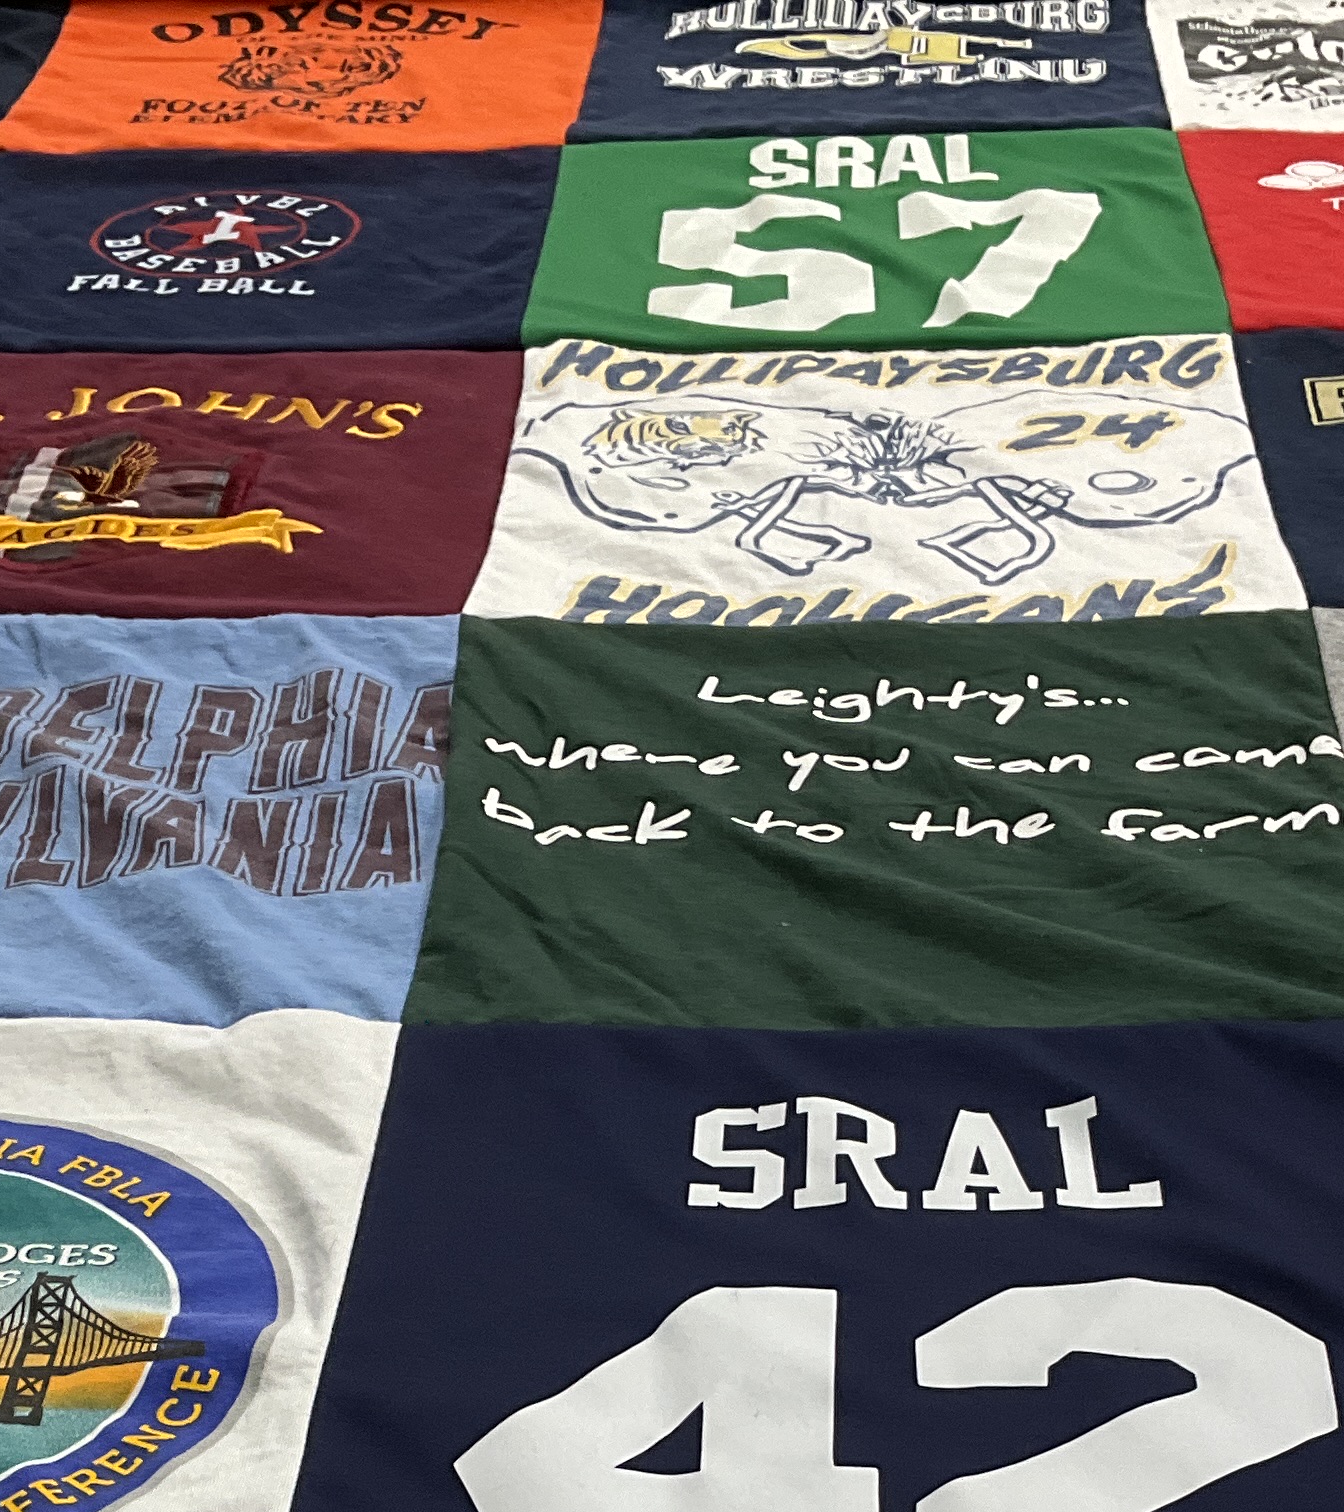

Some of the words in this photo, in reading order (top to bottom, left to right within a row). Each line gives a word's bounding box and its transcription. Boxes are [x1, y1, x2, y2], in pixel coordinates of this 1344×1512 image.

[152, 0, 520, 43] ODYSSEY
[657, 57, 1105, 89] WRESTLING
[749, 134, 999, 188] SRAL
[105, 234, 342, 275] BASEBALL
[647, 188, 1103, 332] 57
[67, 274, 180, 295] FALL
[197, 277, 316, 296] BALL
[540, 338, 1230, 394] HOLLIDAYSBURG
[50, 387, 424, 439] JOHN'S
[1001, 411, 1183, 452] 24
[484, 735, 740, 775] where
[784, 746, 910, 790] you
[955, 750, 1092, 774] can
[482, 787, 692, 846] back
[732, 809, 846, 845] to
[890, 805, 1057, 846] the
[687, 1095, 1164, 1212] SRAL
[56, 1153, 175, 1219] FBLA
